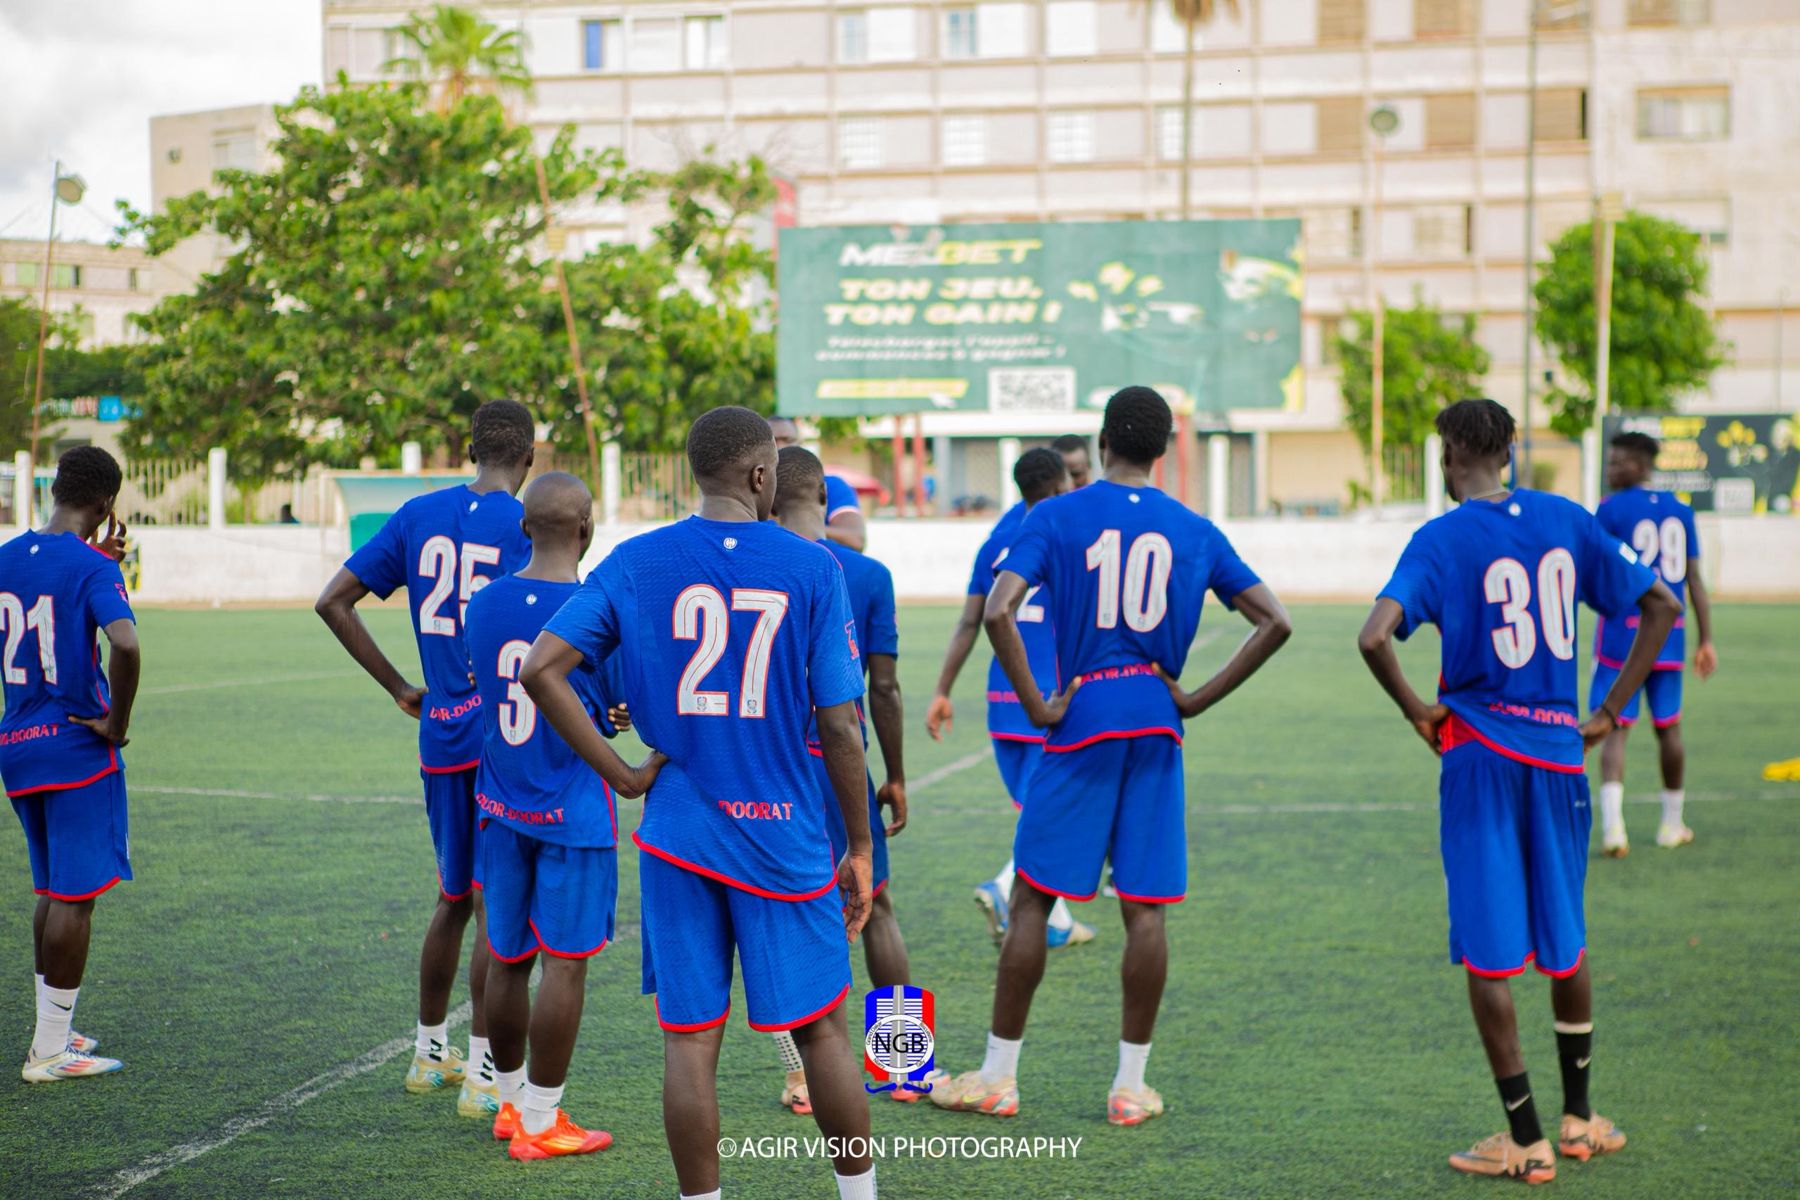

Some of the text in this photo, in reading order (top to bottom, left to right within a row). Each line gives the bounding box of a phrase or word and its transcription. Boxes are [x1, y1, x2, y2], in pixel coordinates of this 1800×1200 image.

[823, 302, 915, 325] TON
[924, 301, 1037, 325] GAIN
[839, 278, 932, 299] TON
[418, 535, 500, 637] 25
[1085, 529, 1173, 633] 10
[1484, 547, 1576, 669] 30
[0, 592, 57, 686] 21
[672, 583, 788, 718] 27
